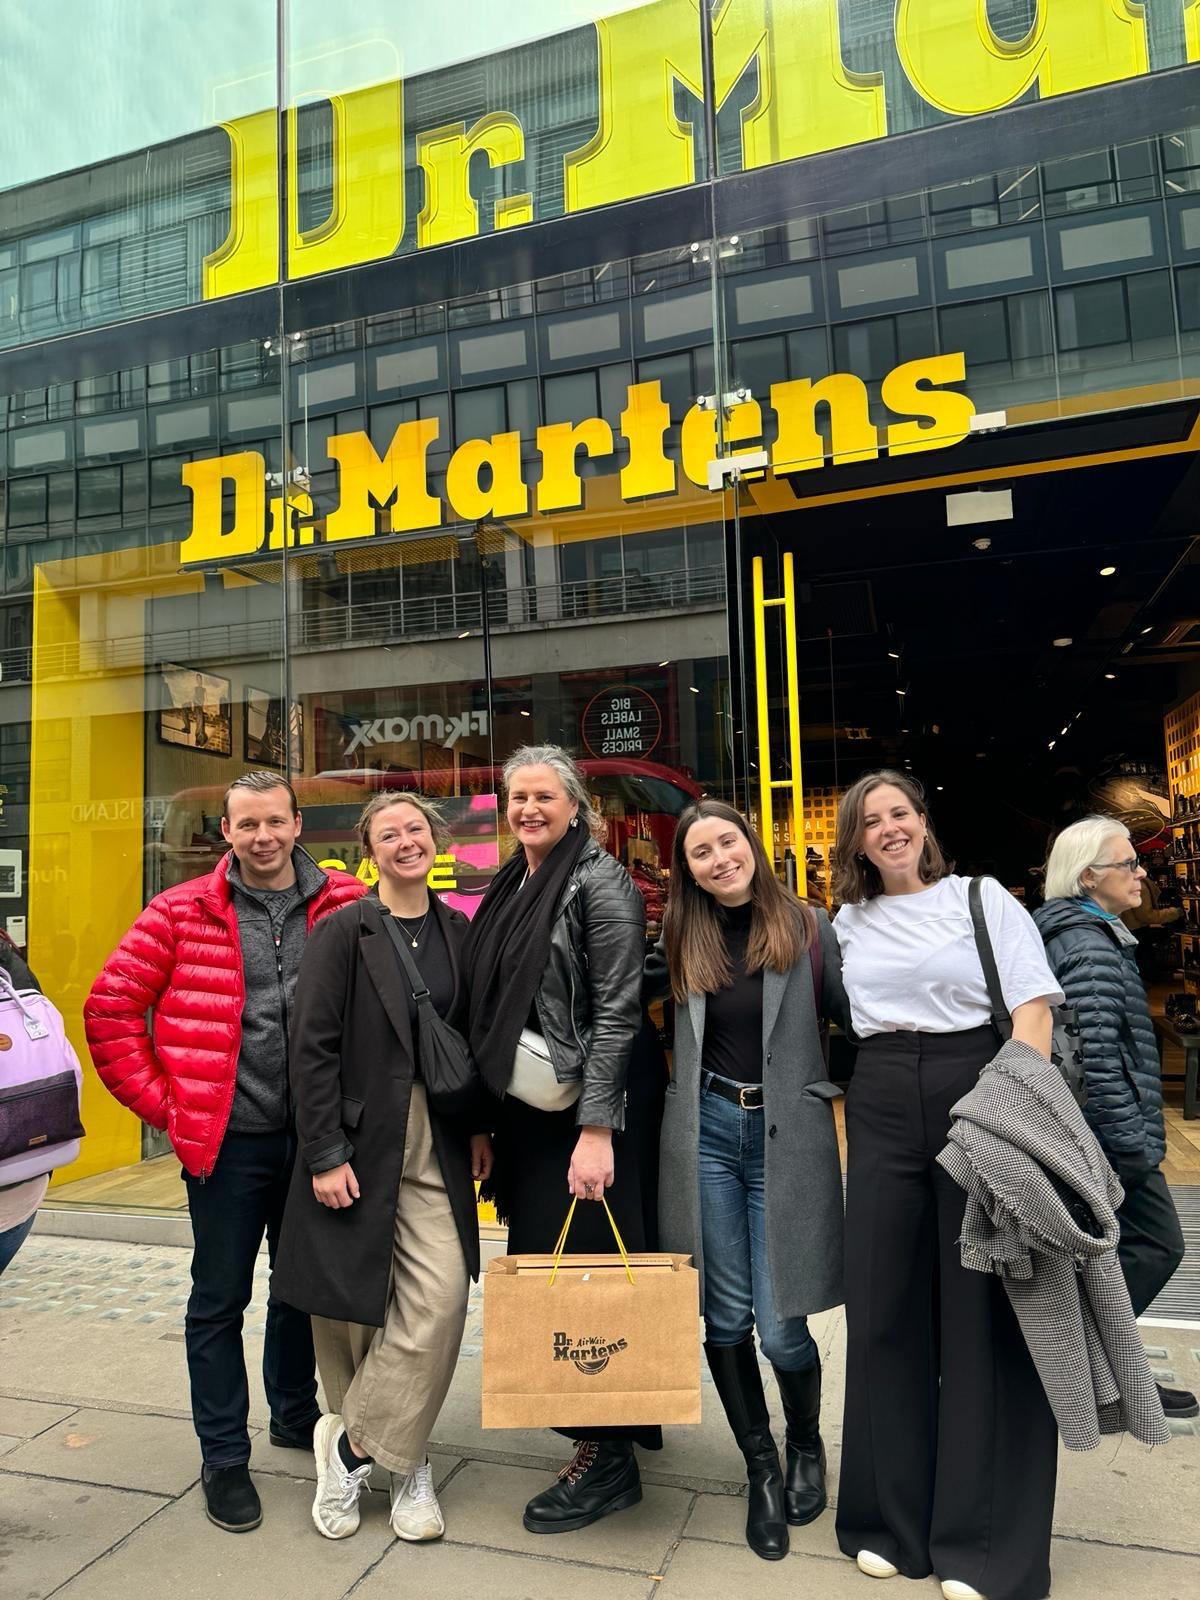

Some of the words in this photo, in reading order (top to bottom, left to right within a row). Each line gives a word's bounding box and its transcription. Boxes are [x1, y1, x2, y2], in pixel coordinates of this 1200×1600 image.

[203, 38, 534, 299] Dr.
[564, 0, 1200, 213] Ma
[180, 449, 314, 564] Dr.
[326, 352, 976, 541] Martens
[318, 853, 457, 889] AE
[553, 1331, 573, 1346] Dr.
[553, 1338, 628, 1361] Martens
